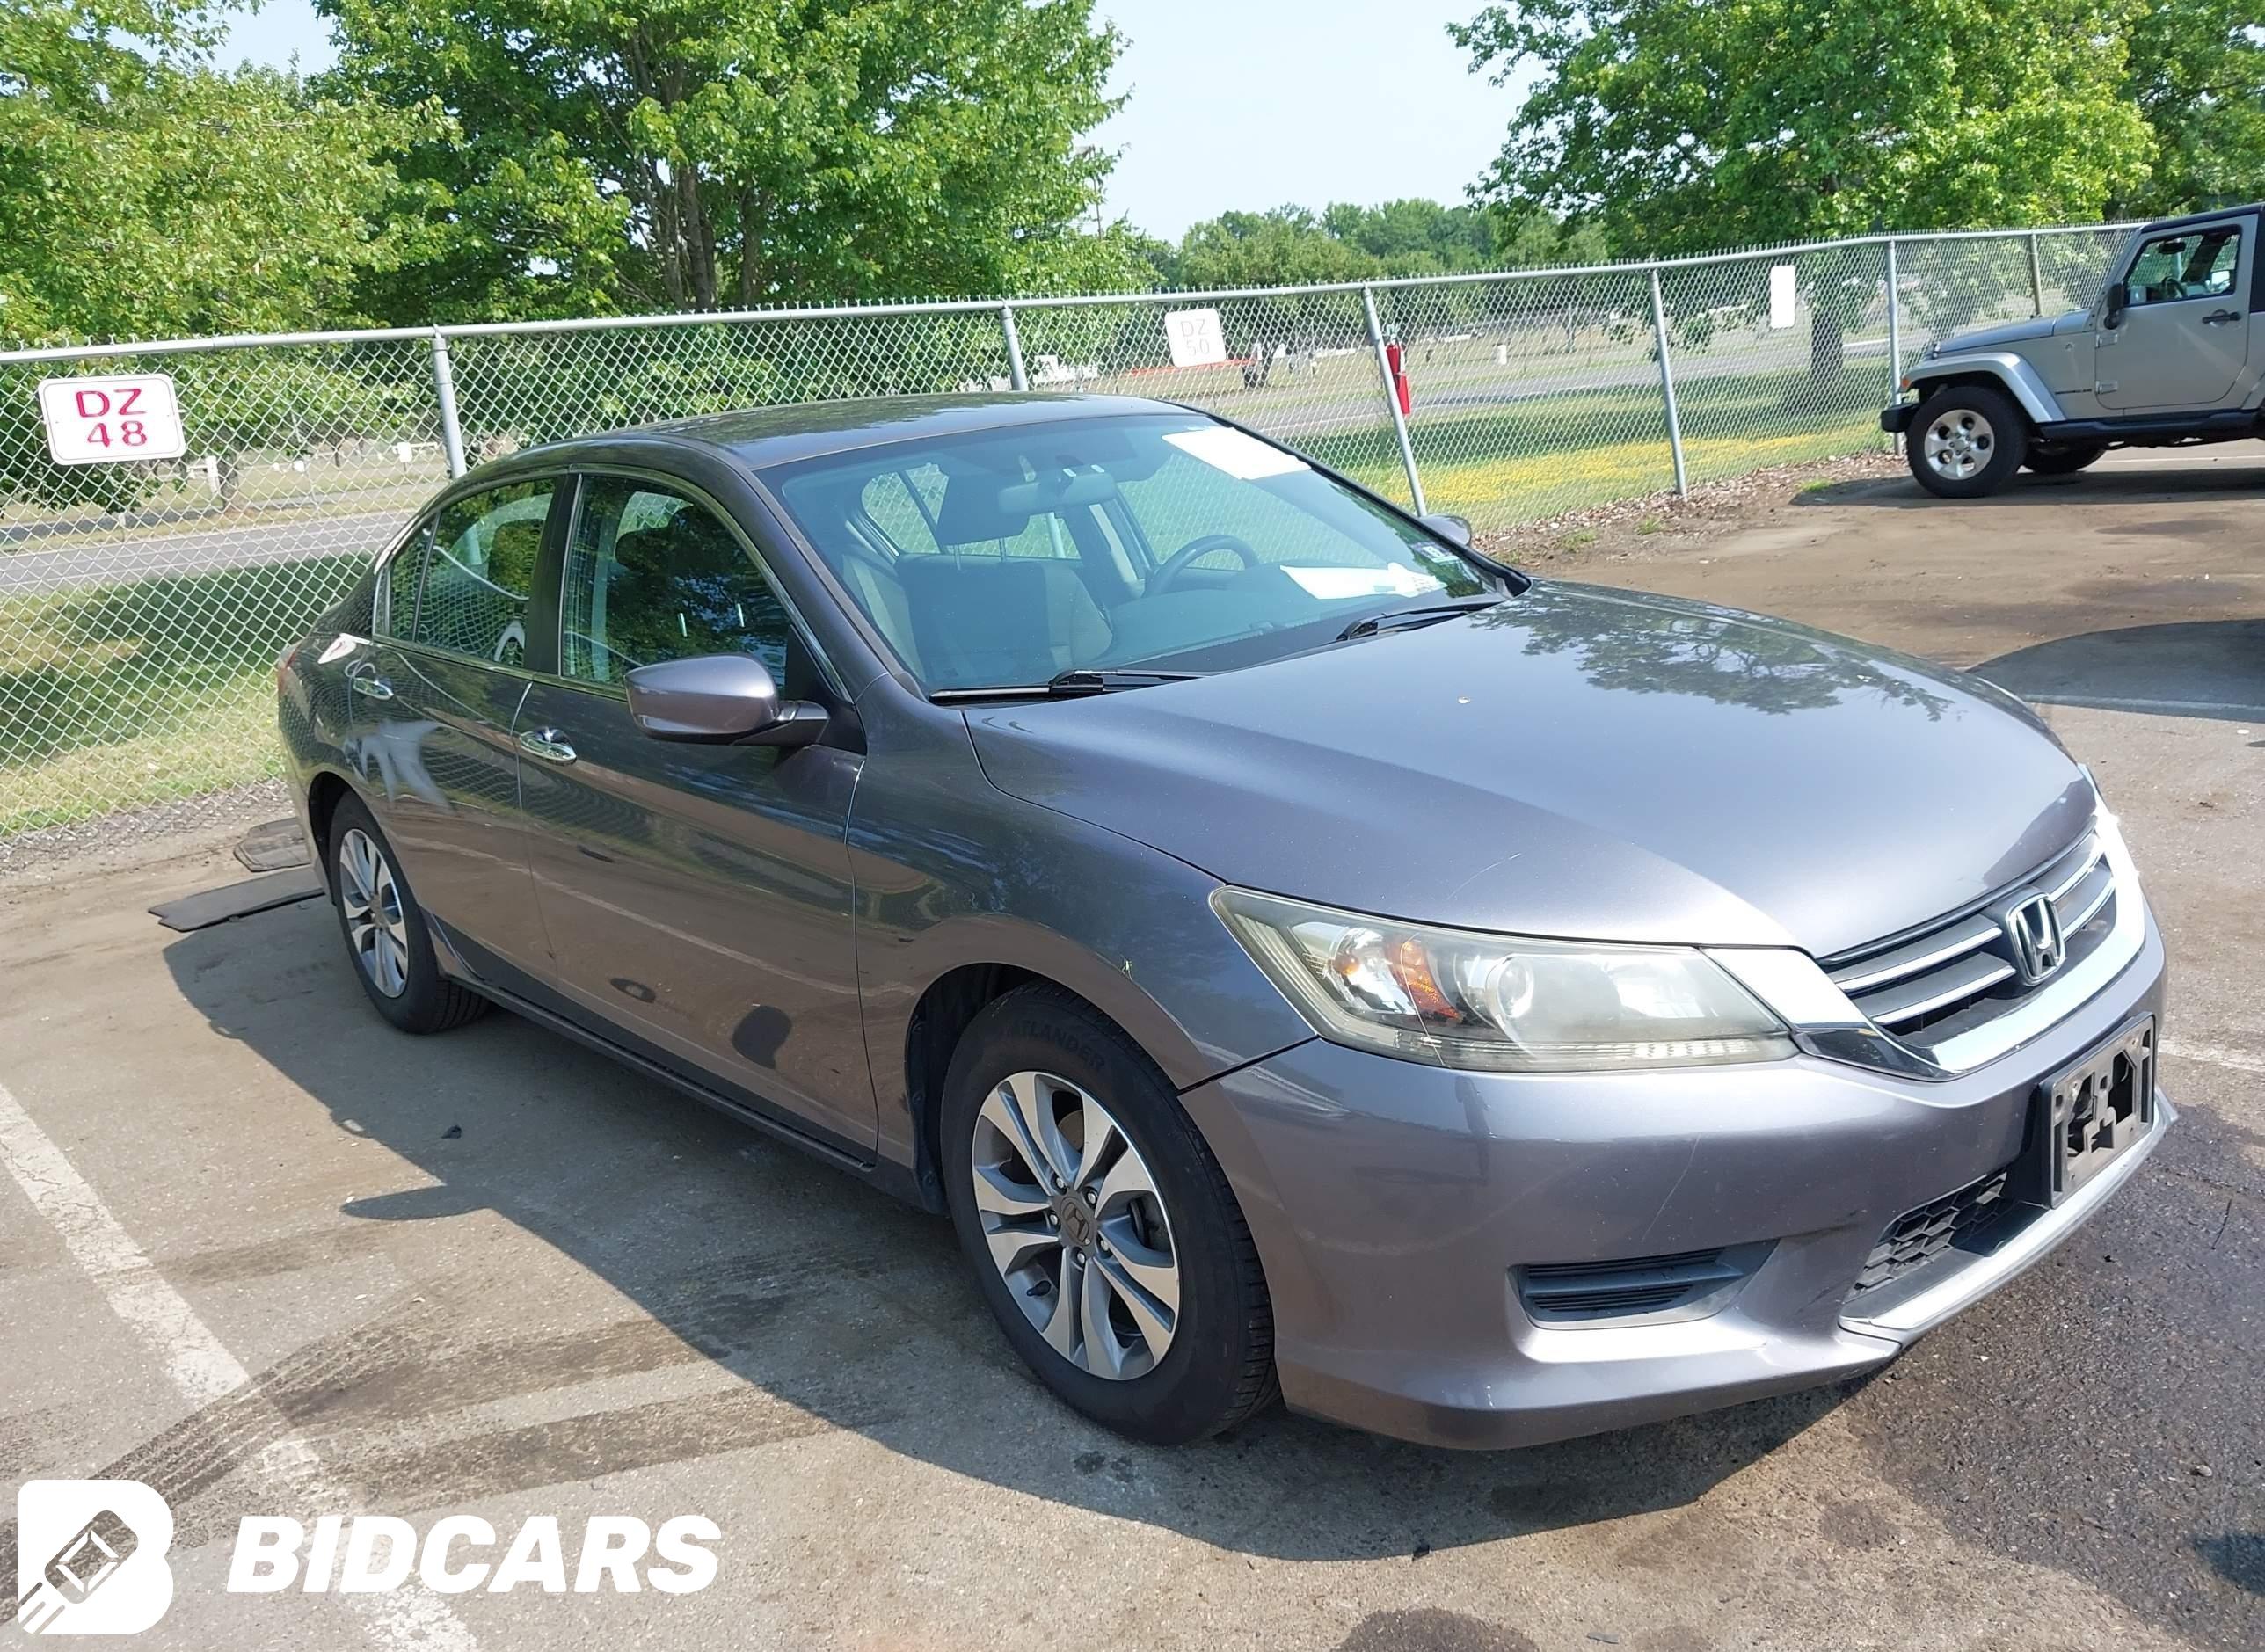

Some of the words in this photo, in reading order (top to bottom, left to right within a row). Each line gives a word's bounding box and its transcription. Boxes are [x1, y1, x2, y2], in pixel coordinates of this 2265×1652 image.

[1180, 319, 1210, 337] DZ
[76, 388, 147, 418] DZ
[87, 420, 148, 448] 48
